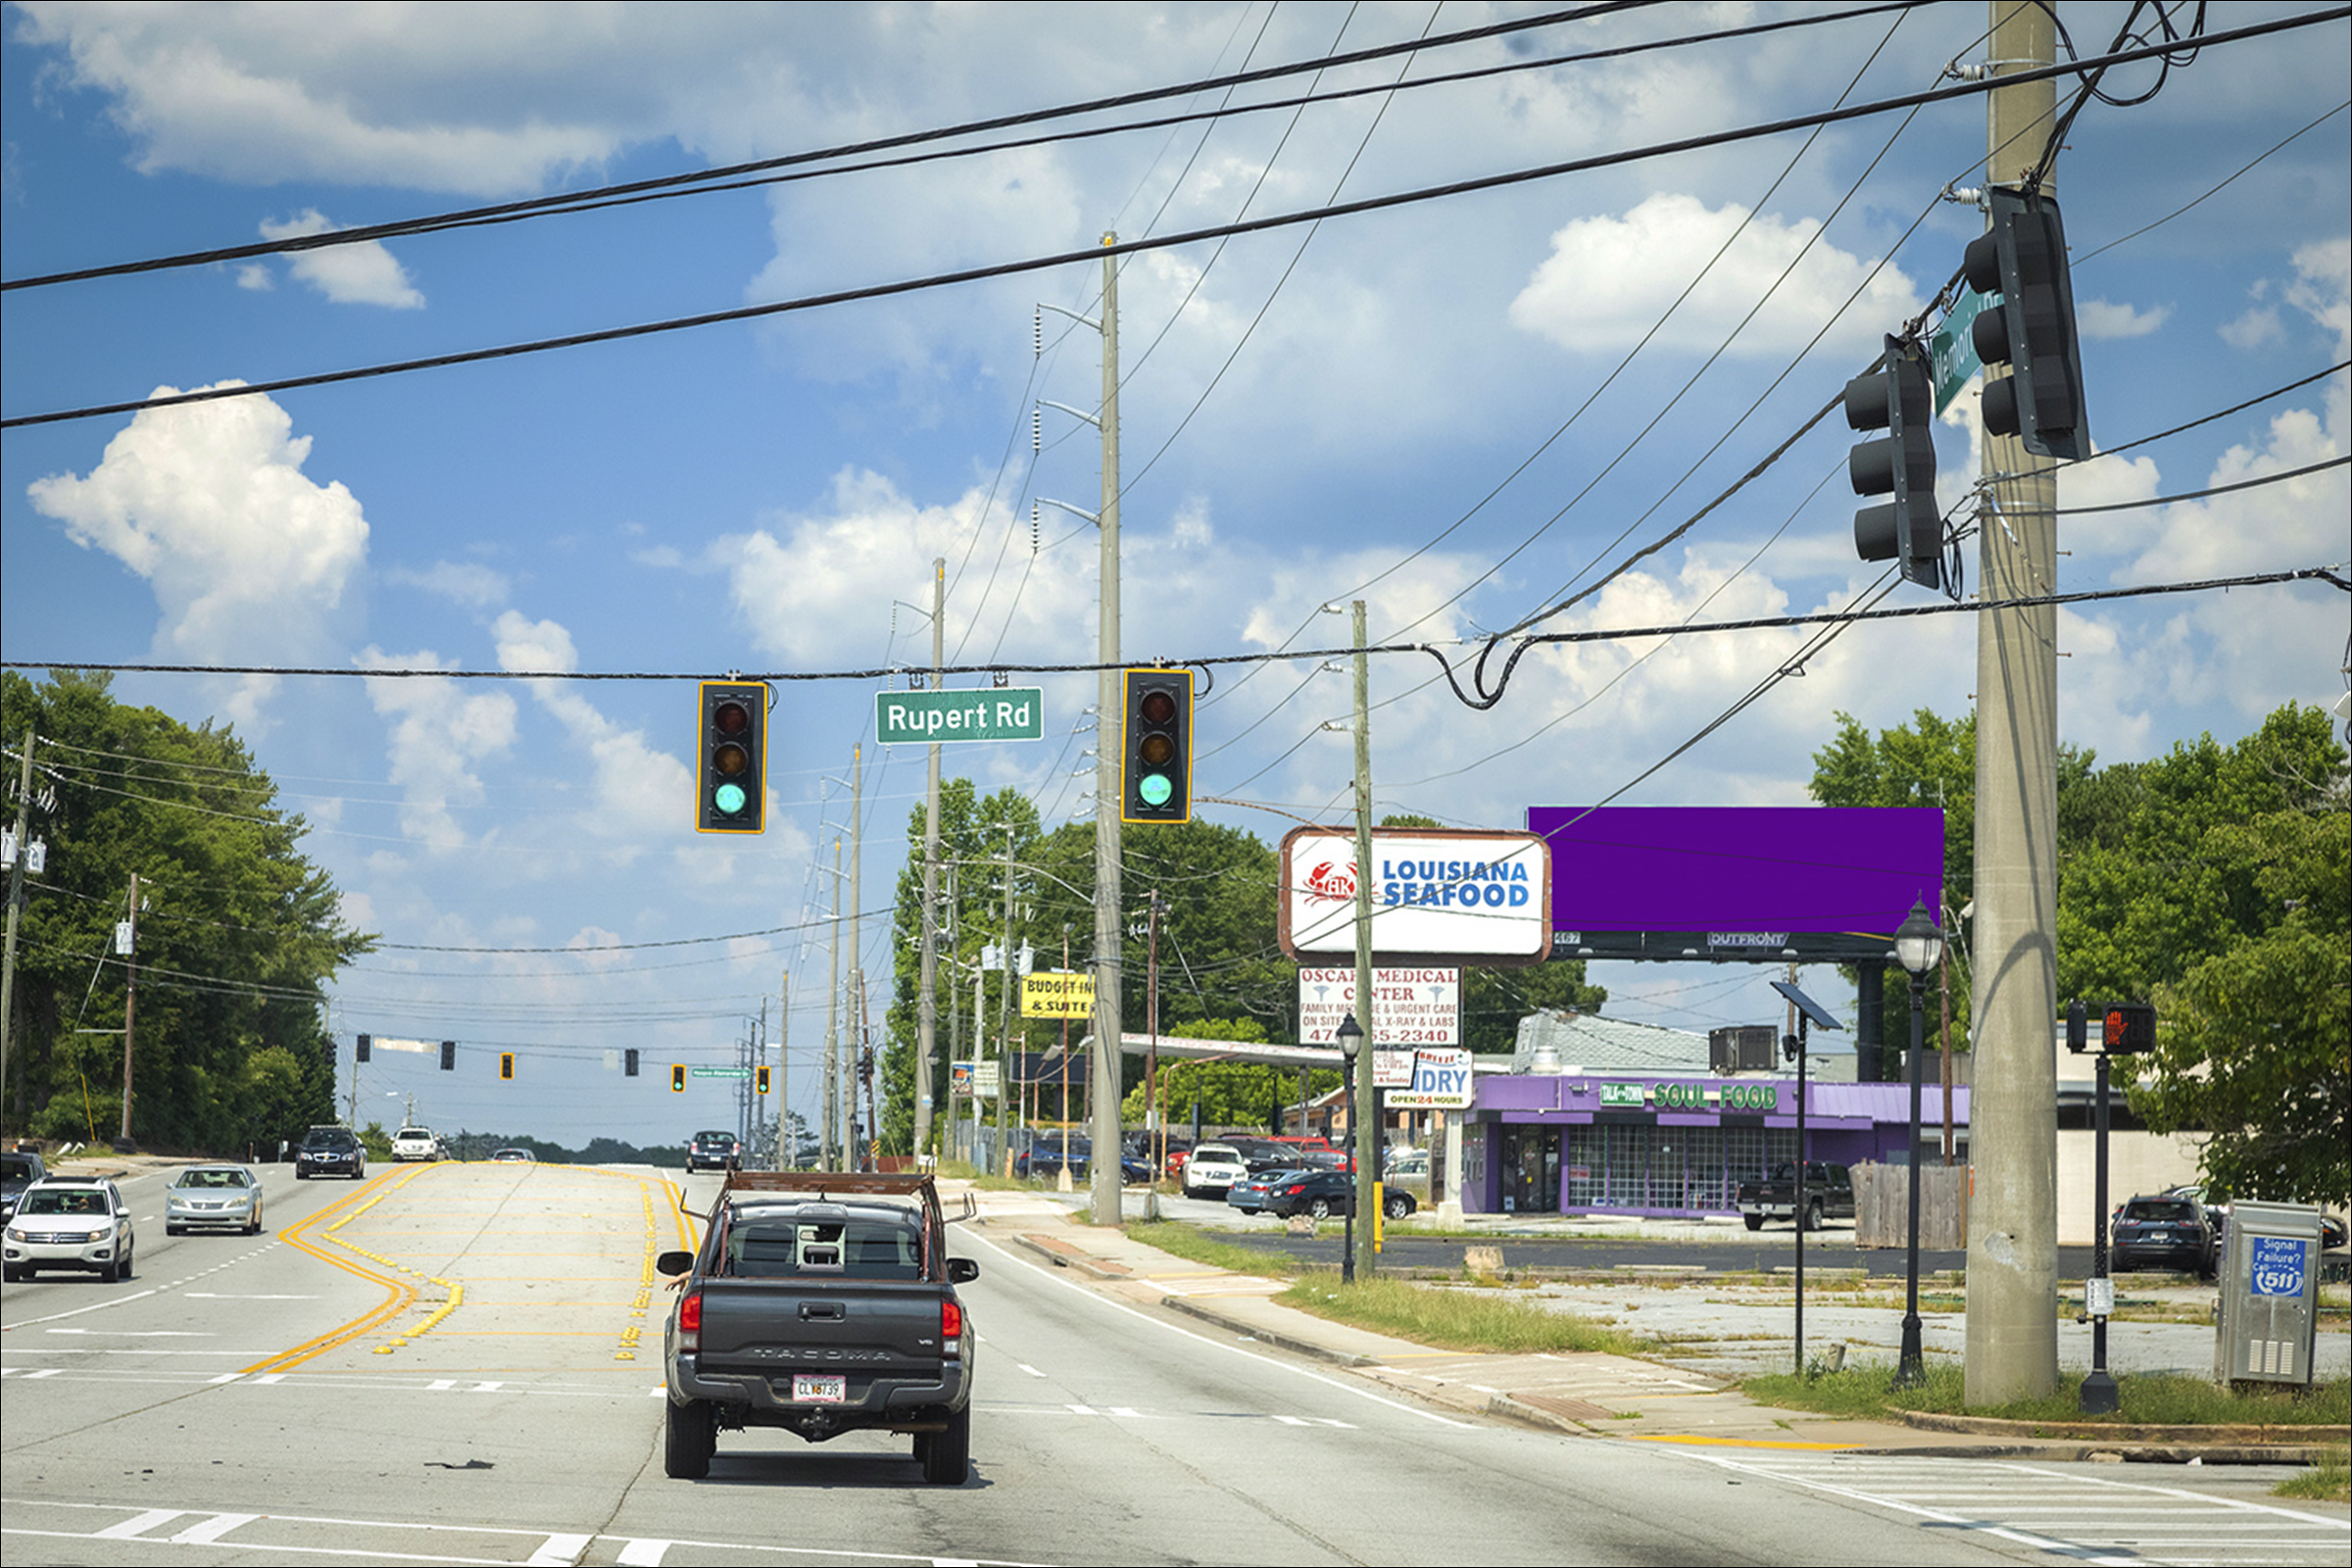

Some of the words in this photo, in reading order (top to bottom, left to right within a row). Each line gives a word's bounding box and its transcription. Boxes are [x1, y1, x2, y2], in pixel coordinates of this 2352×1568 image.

[888, 703, 987, 735] Rupert
[997, 701, 1029, 727] Rd
[1383, 859, 1529, 882] LOUISIANA
[1383, 882, 1529, 907] SEAFOOD
[1711, 933, 1787, 945] OUTFRONT
[1377, 970, 1457, 983] MEDICAL
[1344, 987, 1414, 1001] CNTER
[1032, 1001, 1042, 1011] &
[1300, 1004, 1333, 1013] FAMILY
[1384, 1004, 1390, 1013] &
[1394, 1004, 1431, 1014] URGENT
[1434, 1004, 1456, 1014] CARE
[1303, 1016, 1317, 1026] ON
[1320, 1016, 1340, 1026] SITE
[1386, 1017, 1415, 1027] X-RAY
[1419, 1017, 1426, 1027] &
[1430, 1017, 1454, 1027] LABS
[1417, 1095, 1433, 1104] 24
[1434, 1096, 1463, 1104] HOURS
[1653, 1083, 1711, 1107] SOUL
[1720, 1085, 1778, 1109] FOOD
[2264, 1237, 2297, 1252] Signal
[2257, 1250, 2301, 1264] Failure?
[2265, 1272, 2294, 1289] 511
[754, 1348, 891, 1361] TACOMA
